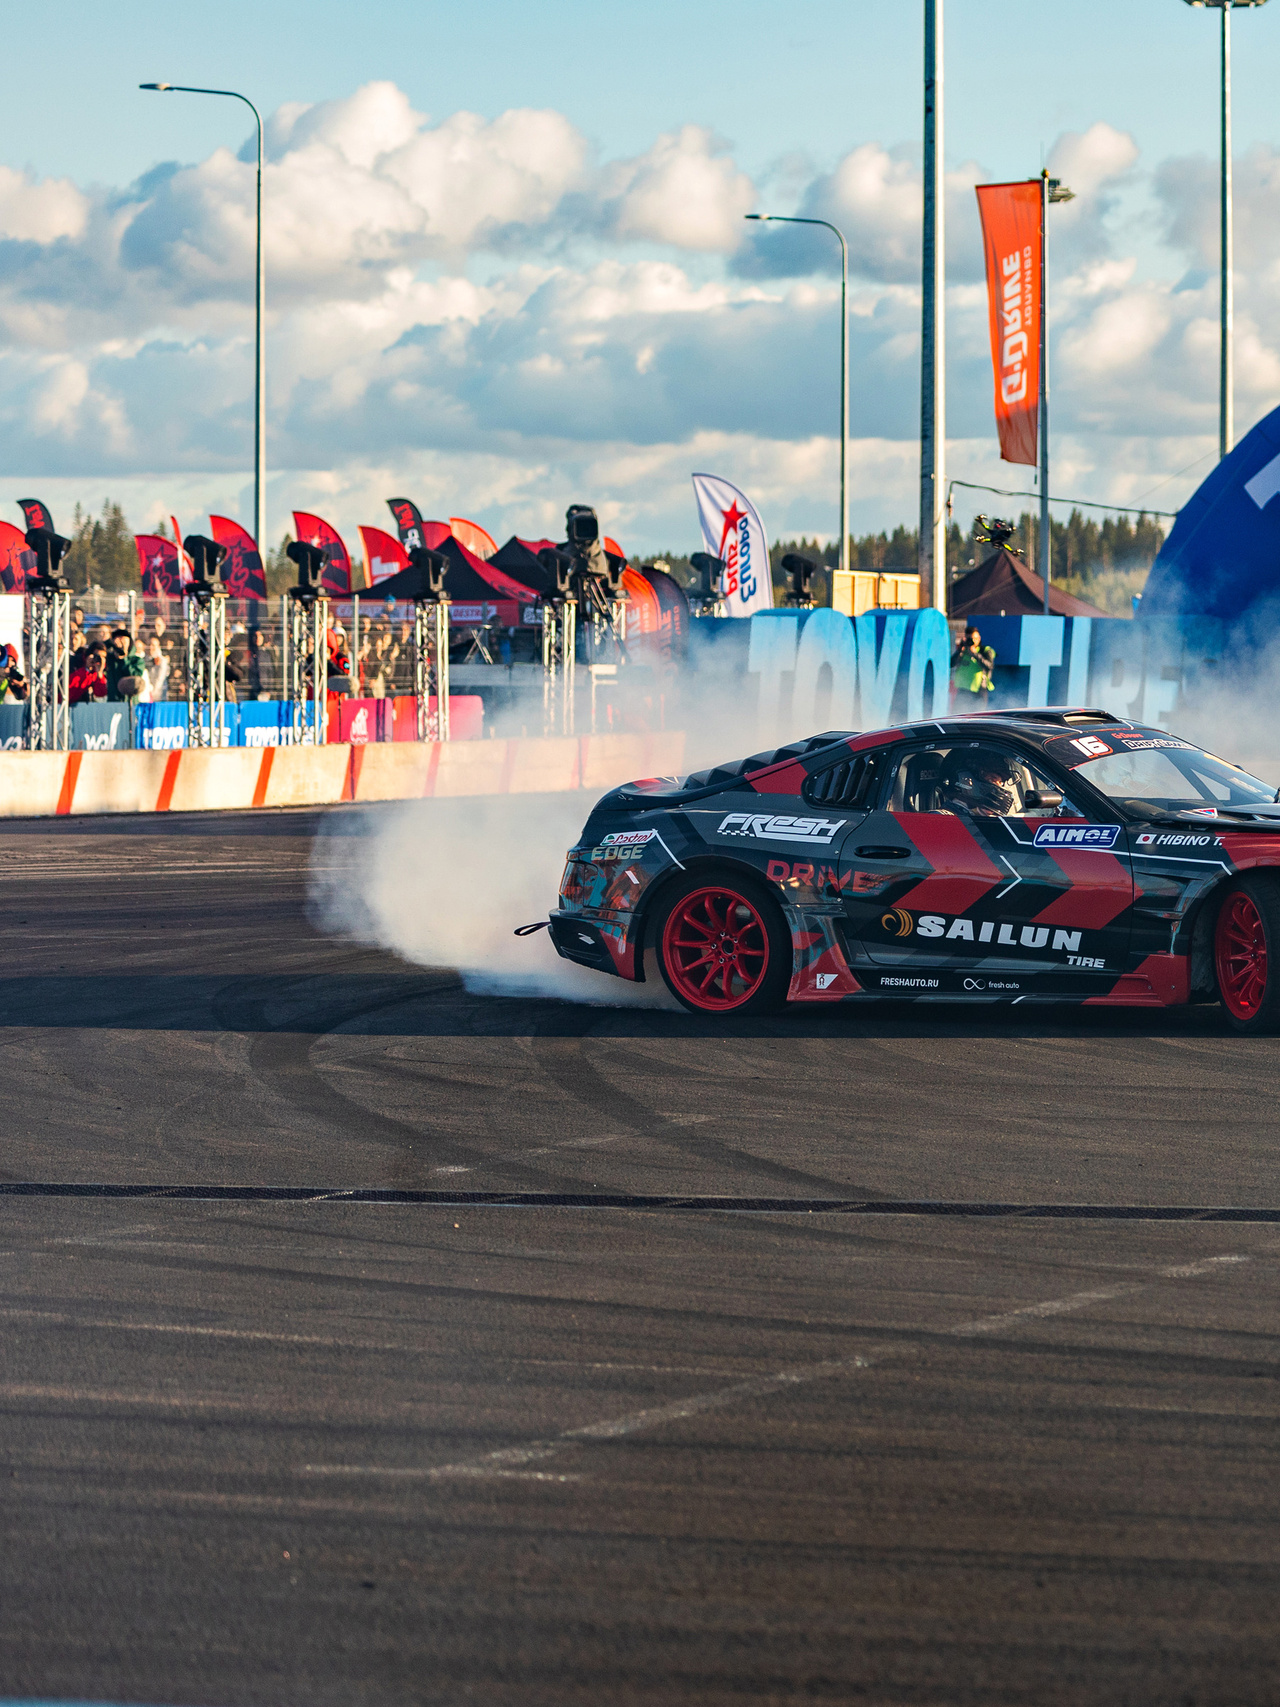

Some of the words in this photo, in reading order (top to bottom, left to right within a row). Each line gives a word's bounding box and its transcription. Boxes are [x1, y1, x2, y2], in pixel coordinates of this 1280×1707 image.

[245, 726, 279, 747] TOYO
[1069, 735, 1112, 758] 16
[612, 832, 653, 844] Castrol
[1037, 829, 1113, 843] AIMOL
[1156, 834, 1211, 846] HIBINO
[1213, 836, 1226, 846] T.
[590, 844, 647, 860] EDGE
[766, 859, 870, 893] DRIVE
[916, 915, 1083, 952] SAILUN
[1066, 955, 1106, 969] TIRE
[880, 977, 939, 988] FRESHAUTO.RU
[988, 981, 1005, 989] fresh
[1005, 981, 1020, 989] auto
